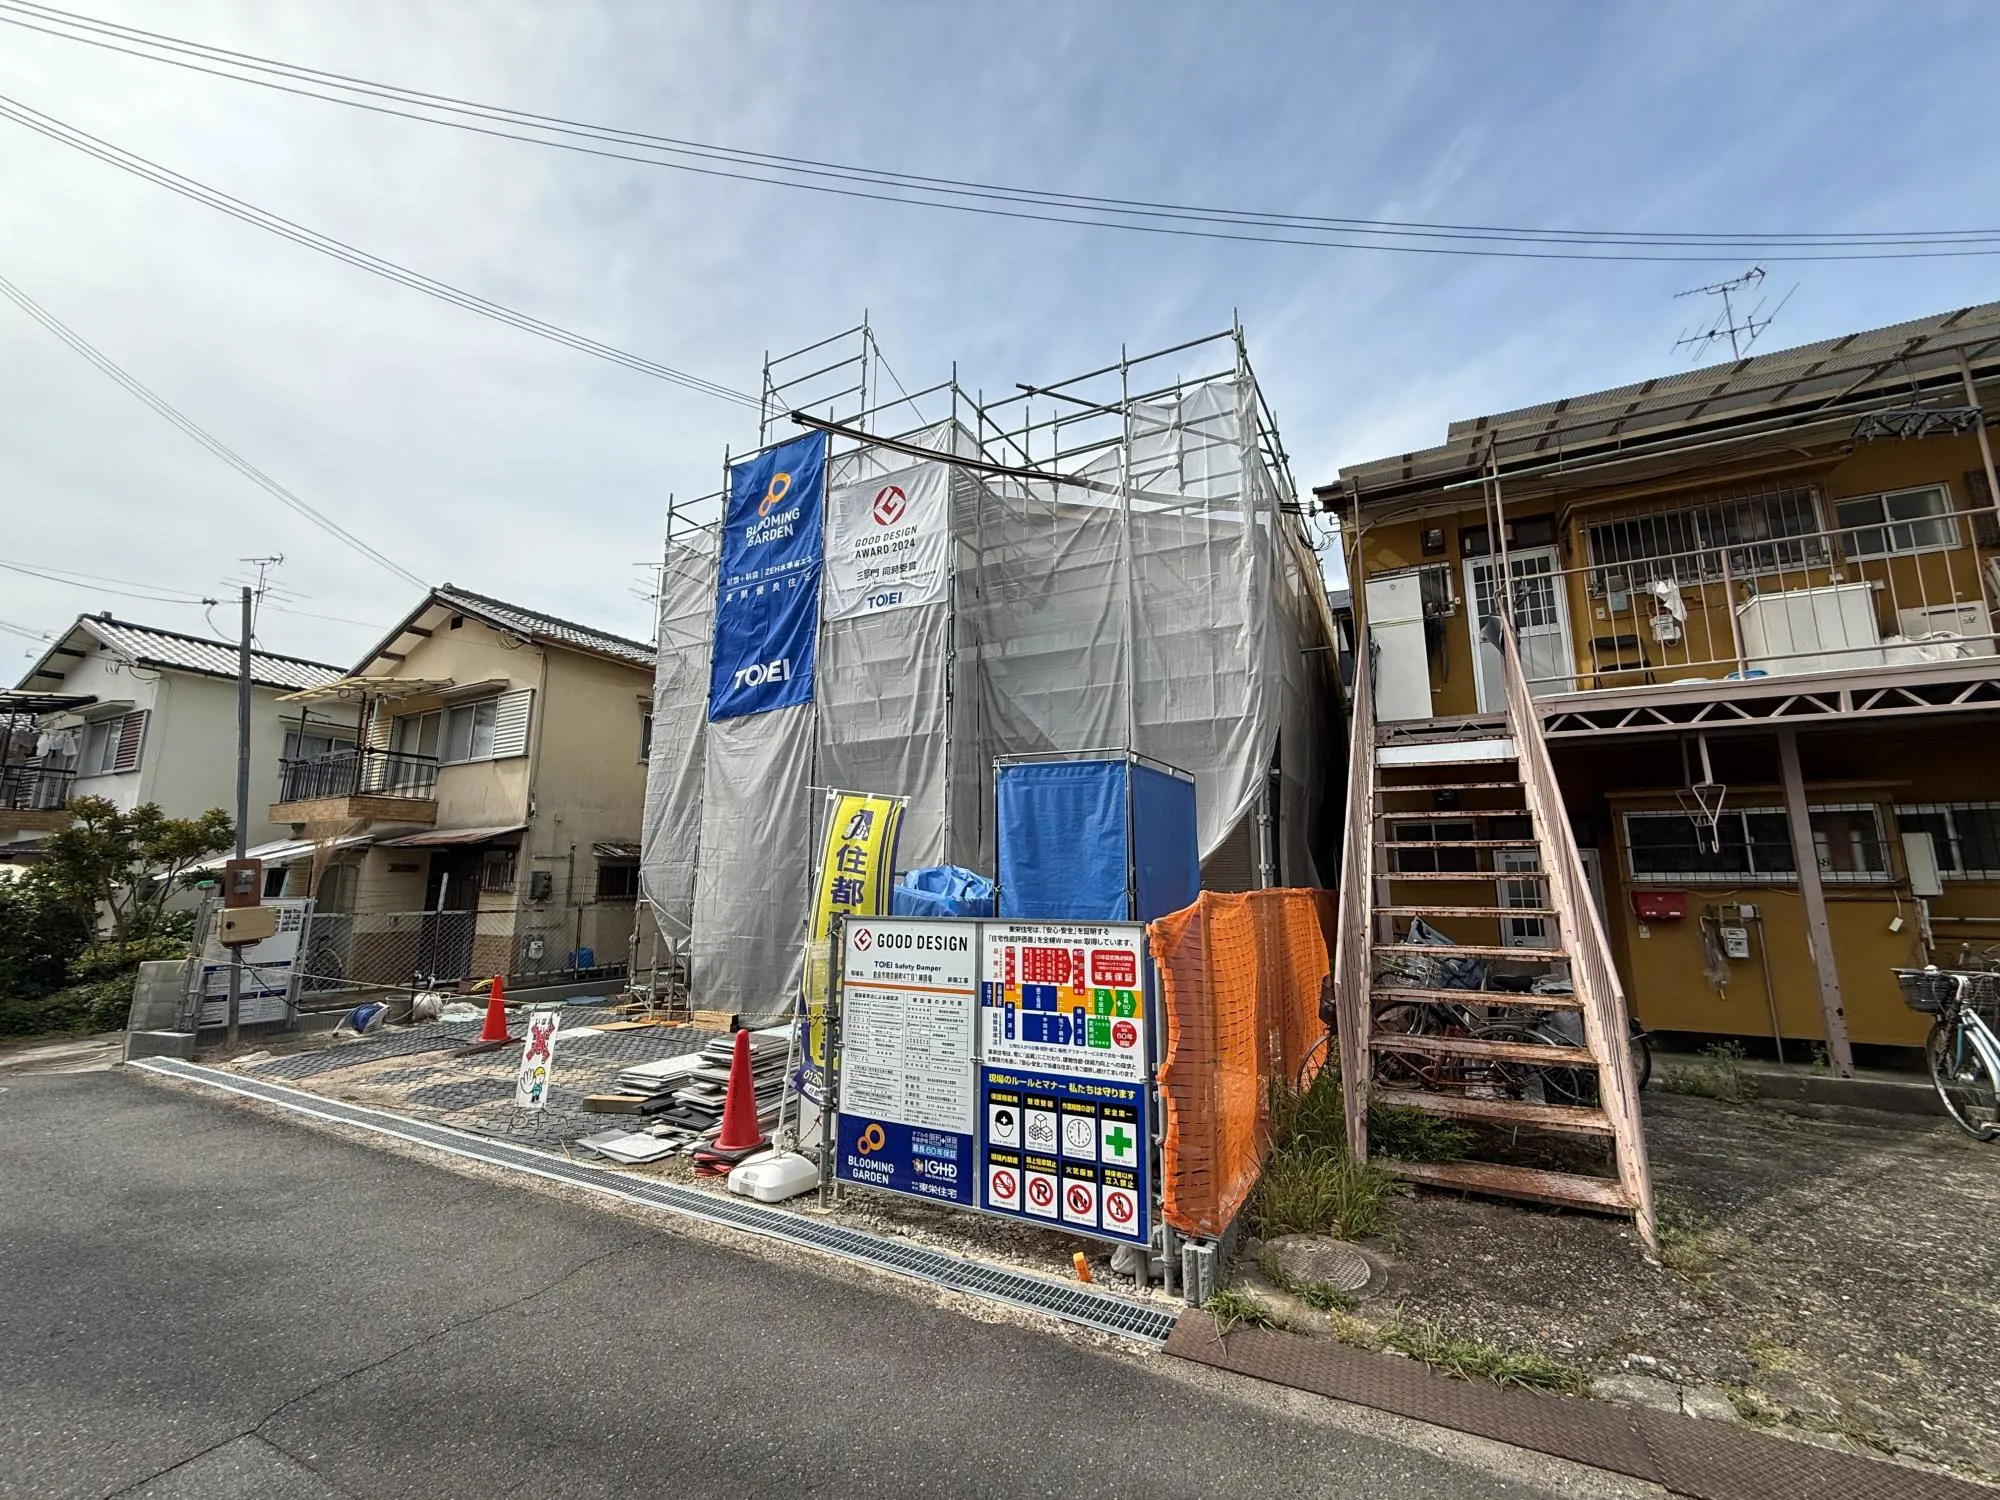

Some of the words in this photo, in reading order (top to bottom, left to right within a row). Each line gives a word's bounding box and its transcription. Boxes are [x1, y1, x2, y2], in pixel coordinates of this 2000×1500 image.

[746, 507, 800, 538] BLOOMING
[747, 523, 794, 547] GARDEN
[855, 535, 881, 548] GOOD
[883, 525, 918, 542] DESIGN
[855, 544, 890, 559] AWARD
[892, 538, 916, 553] 2024
[867, 591, 903, 609] TOEI
[734, 658, 790, 689] TOEI
[877, 933, 912, 949] GOOD
[917, 935, 968, 952] DESIGN
[894, 962, 915, 972] Safety
[916, 964, 942, 972] Damper
[988, 1073, 1067, 1091] 現場のルールとマナー
[1069, 1082, 1136, 1099] 私たちは守ります
[1104, 1108, 1133, 1118] 安全第一
[848, 1155, 895, 1174] BLOOMING
[852, 1168, 889, 1185] GARDEN
[1105, 1177, 1135, 1189] 立入禁止
[919, 1182, 958, 1199] 東栄住宅
